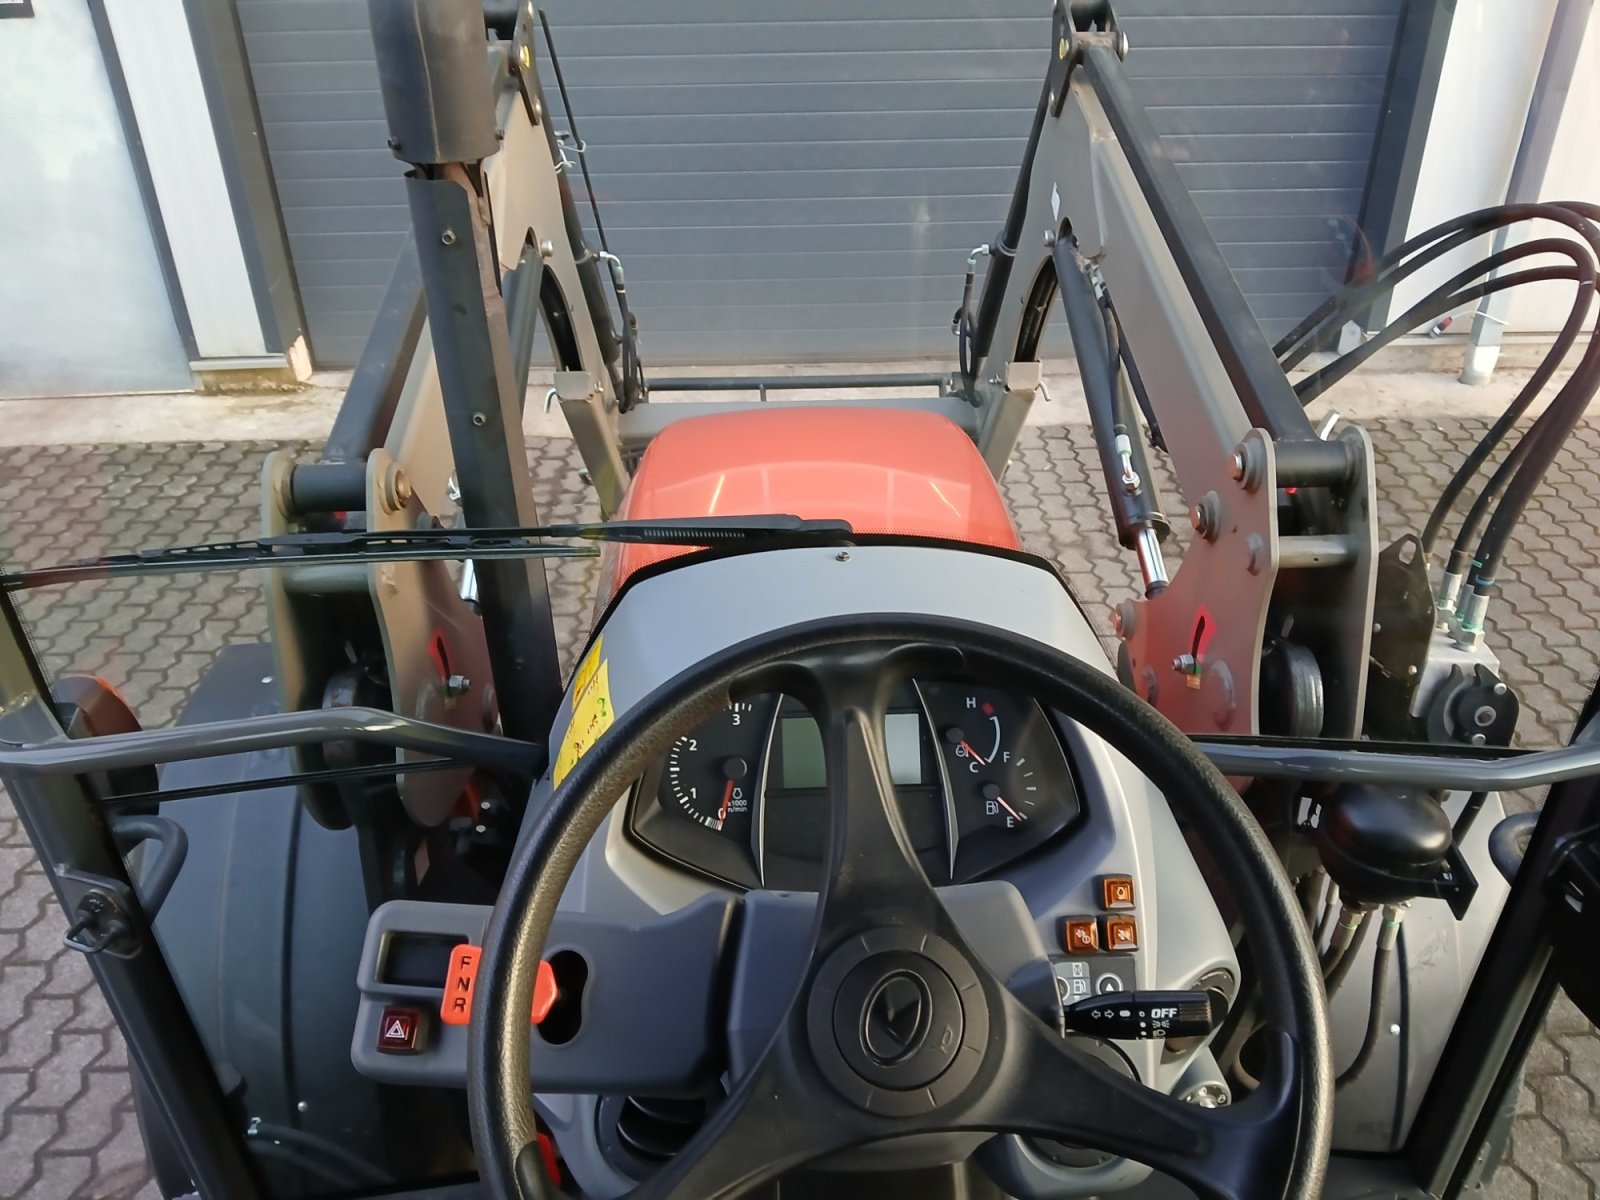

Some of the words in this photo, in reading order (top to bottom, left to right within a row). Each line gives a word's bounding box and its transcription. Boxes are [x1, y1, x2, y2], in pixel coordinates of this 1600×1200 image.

[966, 697, 976, 708] H
[732, 714, 741, 725] 3
[689, 739, 697, 751] 2
[1003, 752, 1010, 763] F
[969, 762, 979, 773] C
[690, 787, 696, 799] 1
[1007, 816, 1014, 828] E
[461, 956, 472, 969] F
[457, 977, 470, 992] N
[454, 998, 466, 1013] R
[1151, 1008, 1177, 1018] OFF
